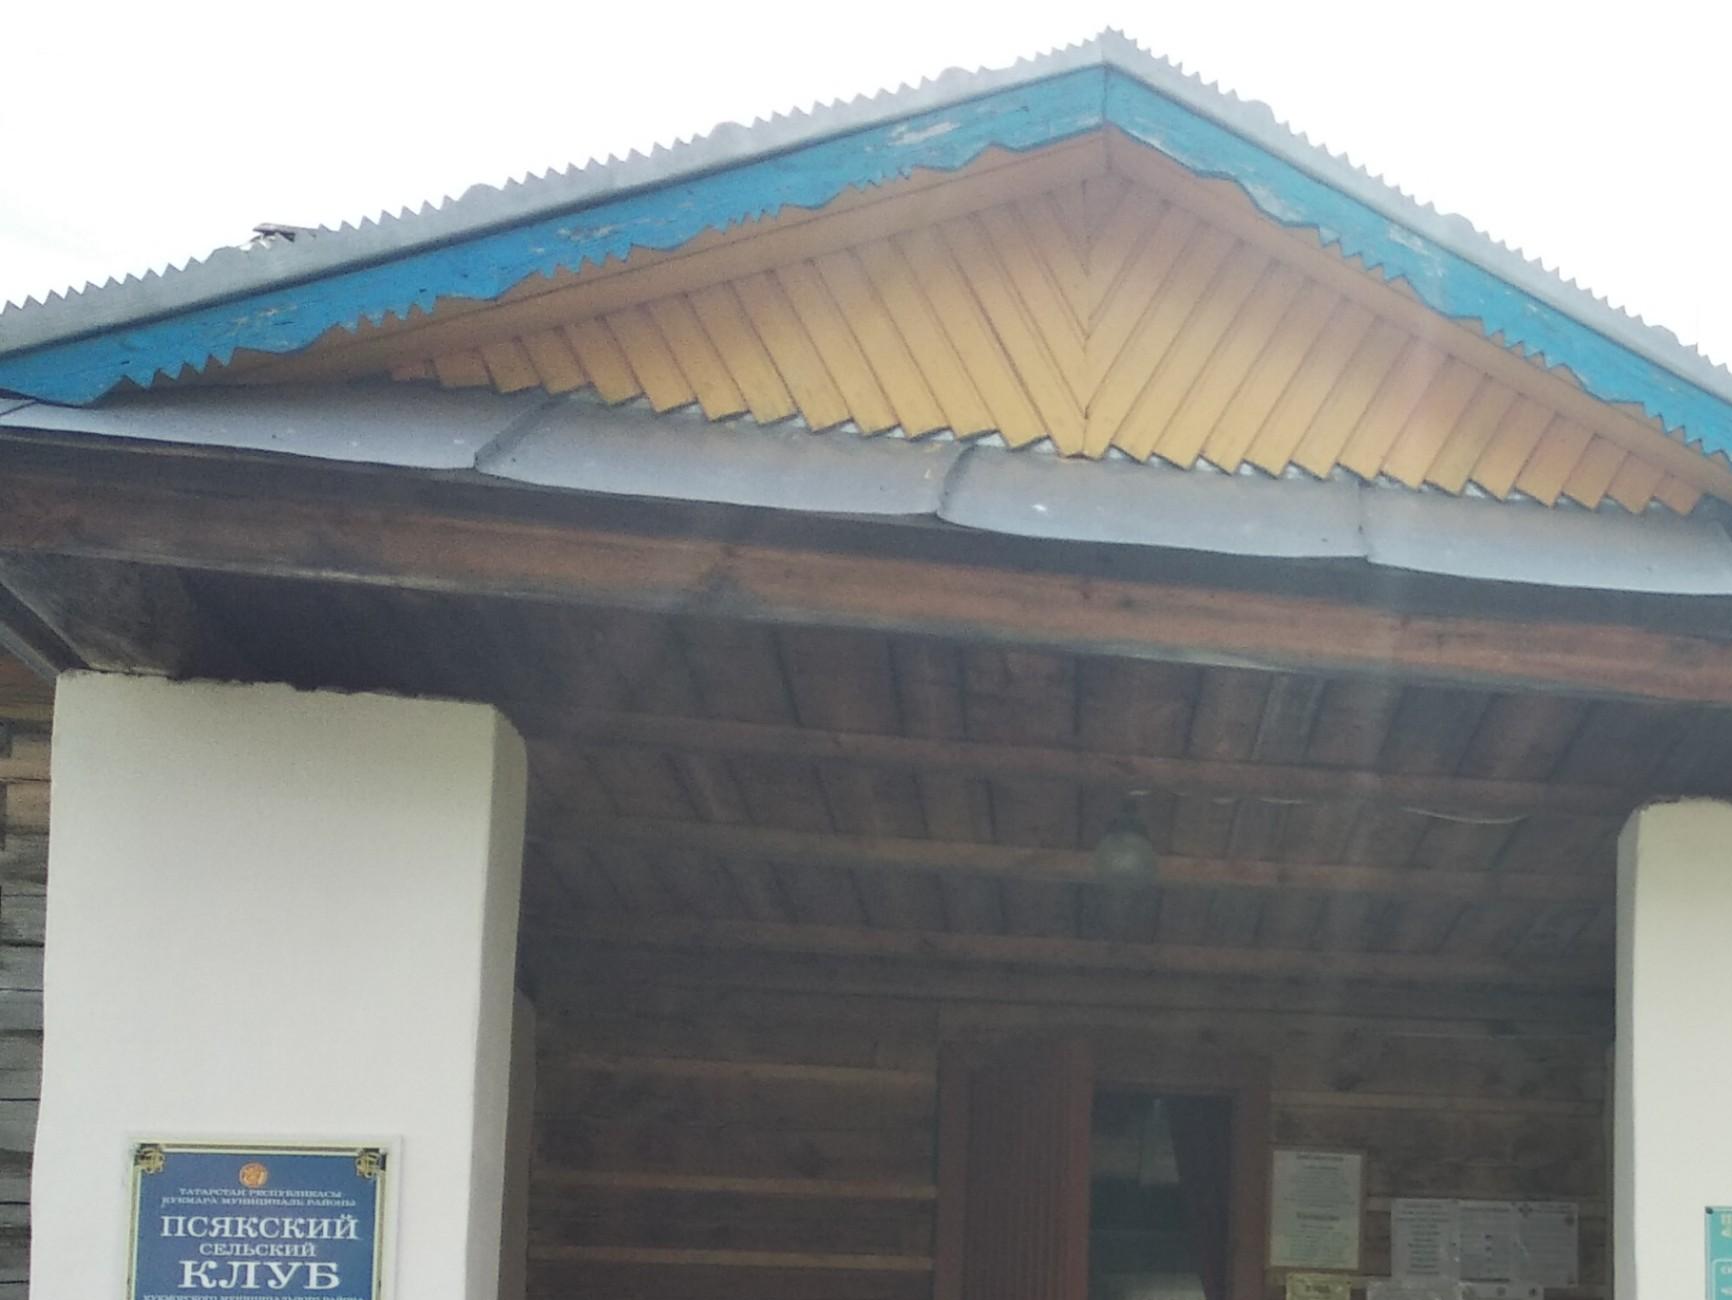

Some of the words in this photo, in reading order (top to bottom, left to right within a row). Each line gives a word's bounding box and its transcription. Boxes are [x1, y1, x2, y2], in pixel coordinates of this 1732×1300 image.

[160, 1214, 360, 1239] ПСЯКСКИЙ
[199, 1242, 317, 1257] СЕЛЬСКИЙ
[178, 1260, 341, 1290] КЛУБ
